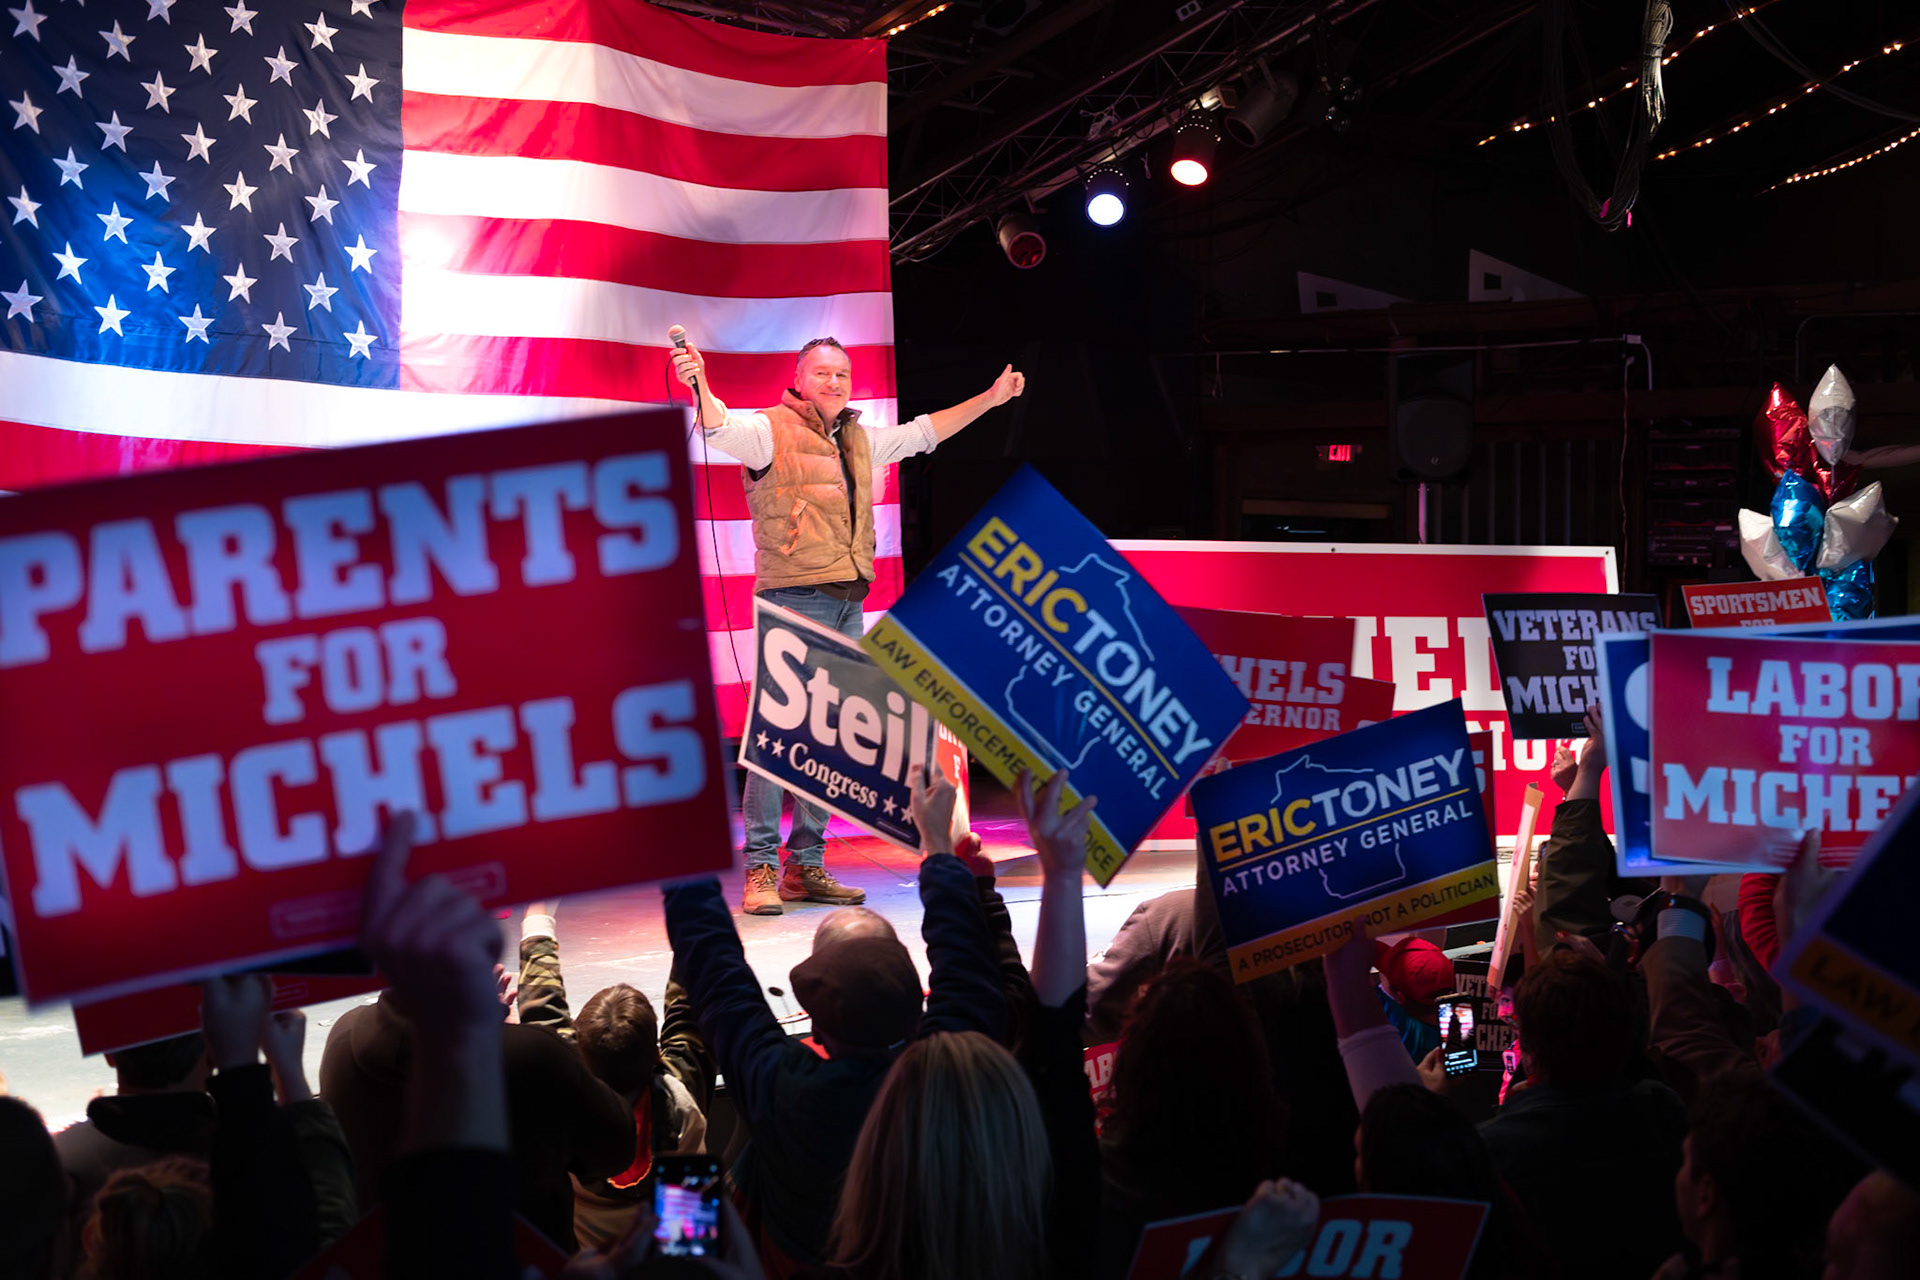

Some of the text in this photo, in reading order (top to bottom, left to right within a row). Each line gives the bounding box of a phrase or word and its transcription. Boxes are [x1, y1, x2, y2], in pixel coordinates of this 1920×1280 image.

[0, 452, 680, 668] PARENTS
[1492, 609, 1657, 641] VETERANS
[1690, 587, 1824, 616] SPORTSMEN
[256, 617, 456, 725] FOR
[870, 628, 917, 670] LAW
[936, 564, 1167, 800] ATTORNEY GENERAL
[1213, 654, 1346, 705] HELS
[1562, 645, 1597, 671] FO
[758, 627, 929, 788] Steil
[1245, 702, 1342, 731] ERNOR
[788, 742, 879, 809] Congress
[1779, 724, 1874, 766] FOR
[15, 679, 709, 918] MICHELS
[1662, 763, 1918, 832] MICHE
[1222, 800, 1473, 896] ATTORNEY GENERAL
[1237, 873, 1496, 973] A PROSECUTOR NOT A POLITICIAN
